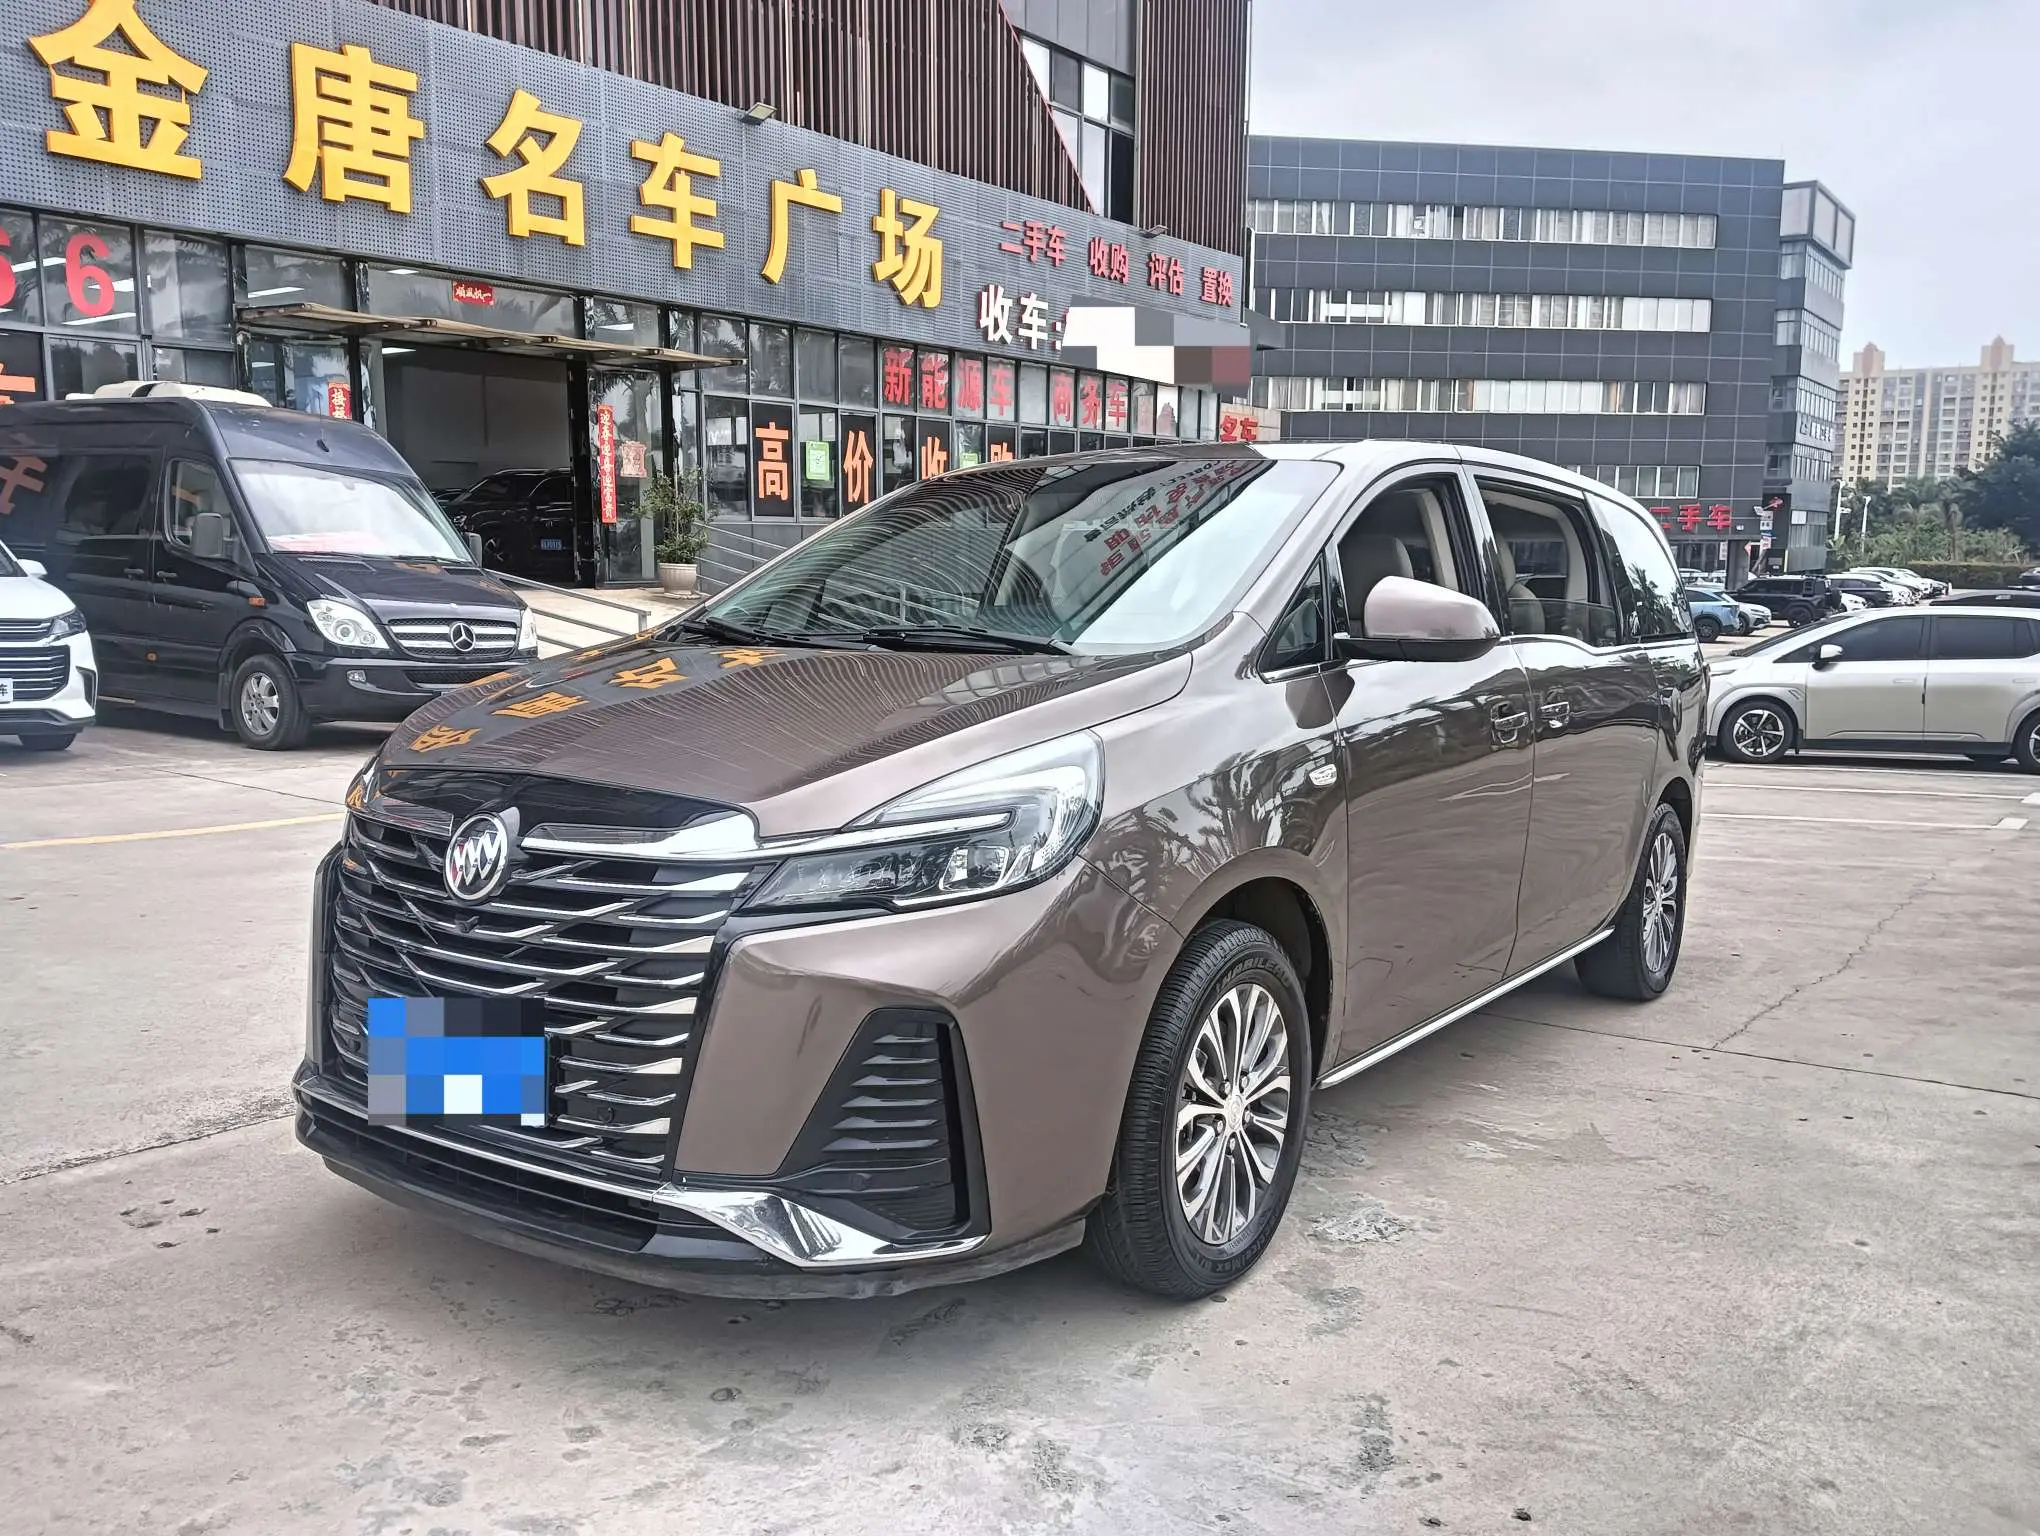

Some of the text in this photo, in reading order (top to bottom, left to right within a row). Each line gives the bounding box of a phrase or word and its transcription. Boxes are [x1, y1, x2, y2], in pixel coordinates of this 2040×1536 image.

[27, 0, 943, 309] 金唐名车广场
[999, 219, 1233, 307] 二手车 收购 评估 置换
[883, 346, 1127, 430] 新能源车 商务车
[1649, 503, 1733, 532] 二手车
